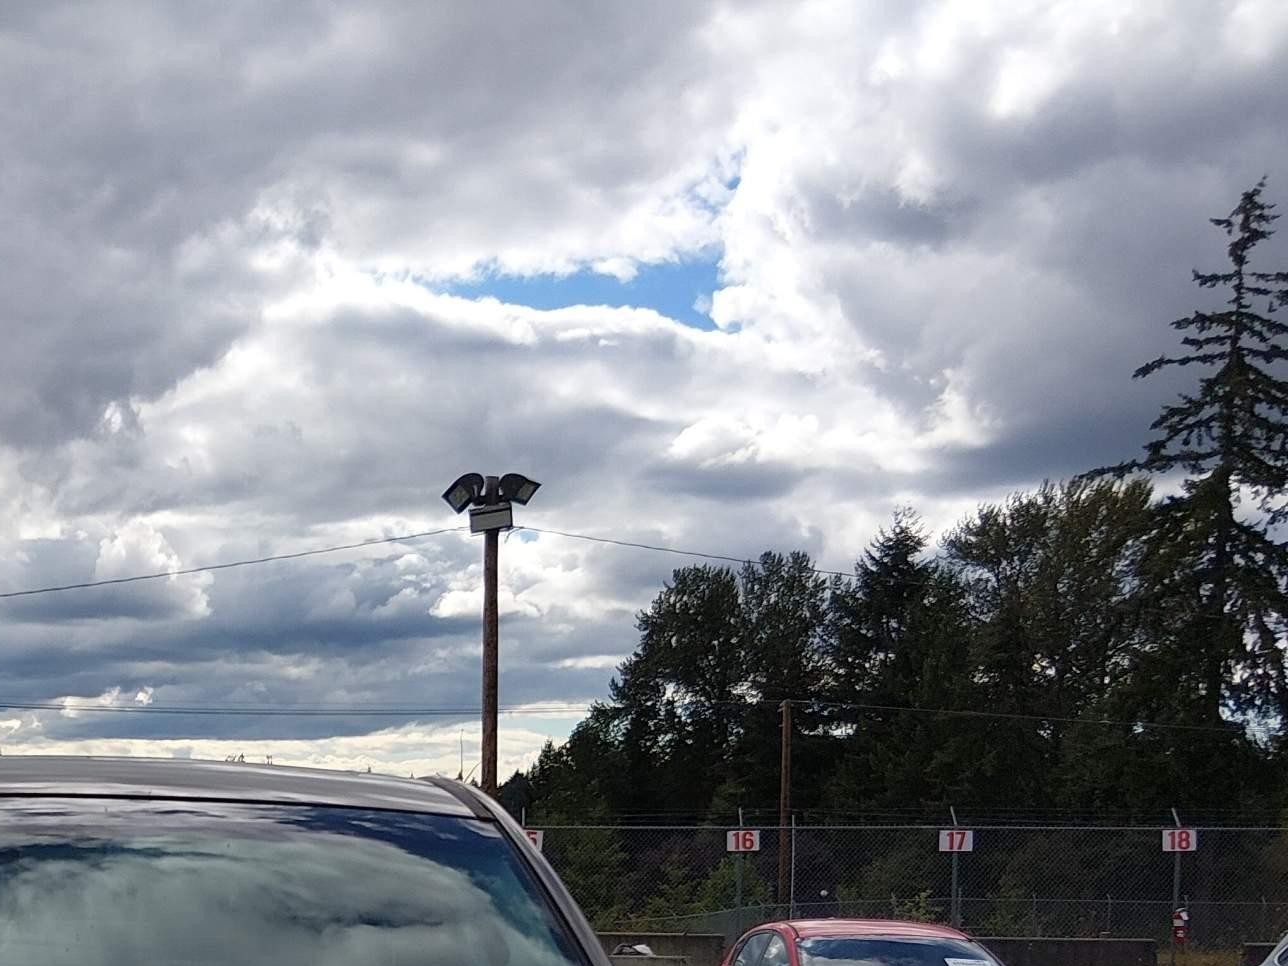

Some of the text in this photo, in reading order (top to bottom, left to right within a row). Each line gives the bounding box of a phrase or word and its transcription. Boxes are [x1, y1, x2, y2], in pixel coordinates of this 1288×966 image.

[732, 831, 754, 850] 16
[946, 831, 966, 850] 17
[1167, 831, 1190, 850] 18
